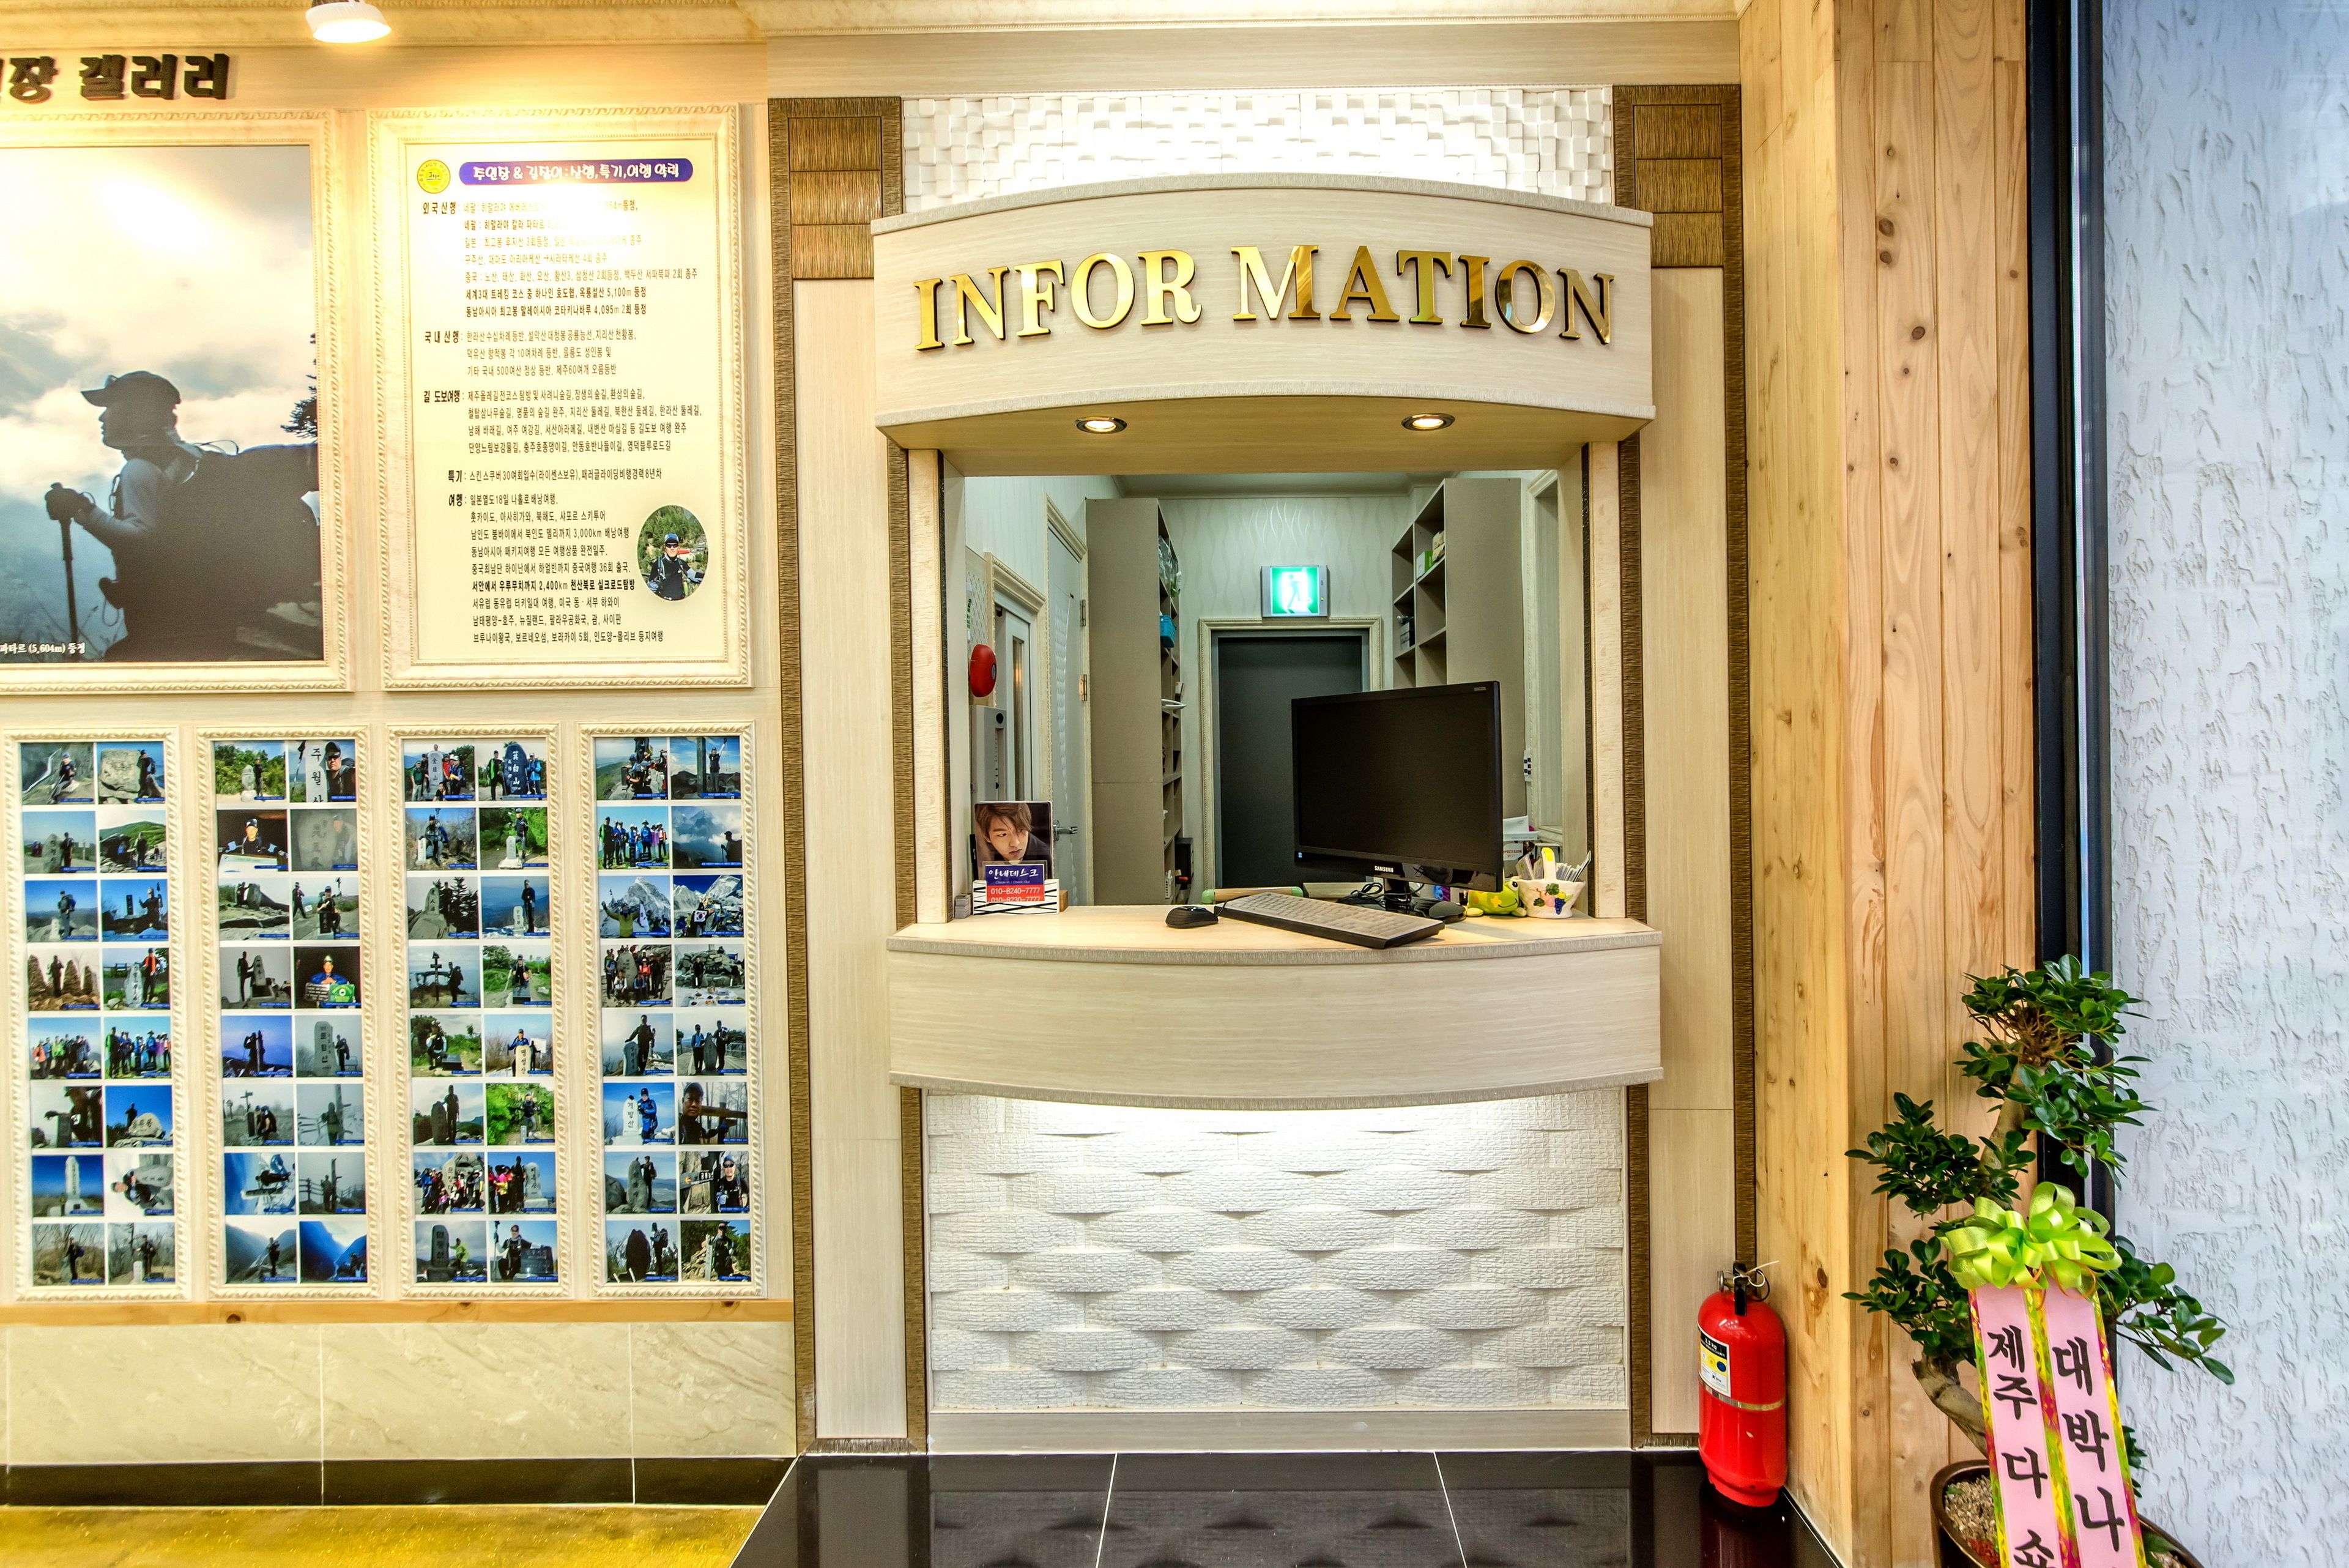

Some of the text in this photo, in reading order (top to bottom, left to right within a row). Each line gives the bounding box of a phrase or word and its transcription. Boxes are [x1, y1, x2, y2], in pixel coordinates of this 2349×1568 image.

[78, 53, 231, 102] 갤러리
[513, 167, 524, 179] &
[67, 642, 86, 655] 등정
[989, 868, 1039, 880] 안내데스크
[990, 886, 1041, 895] 010-8240-7777
